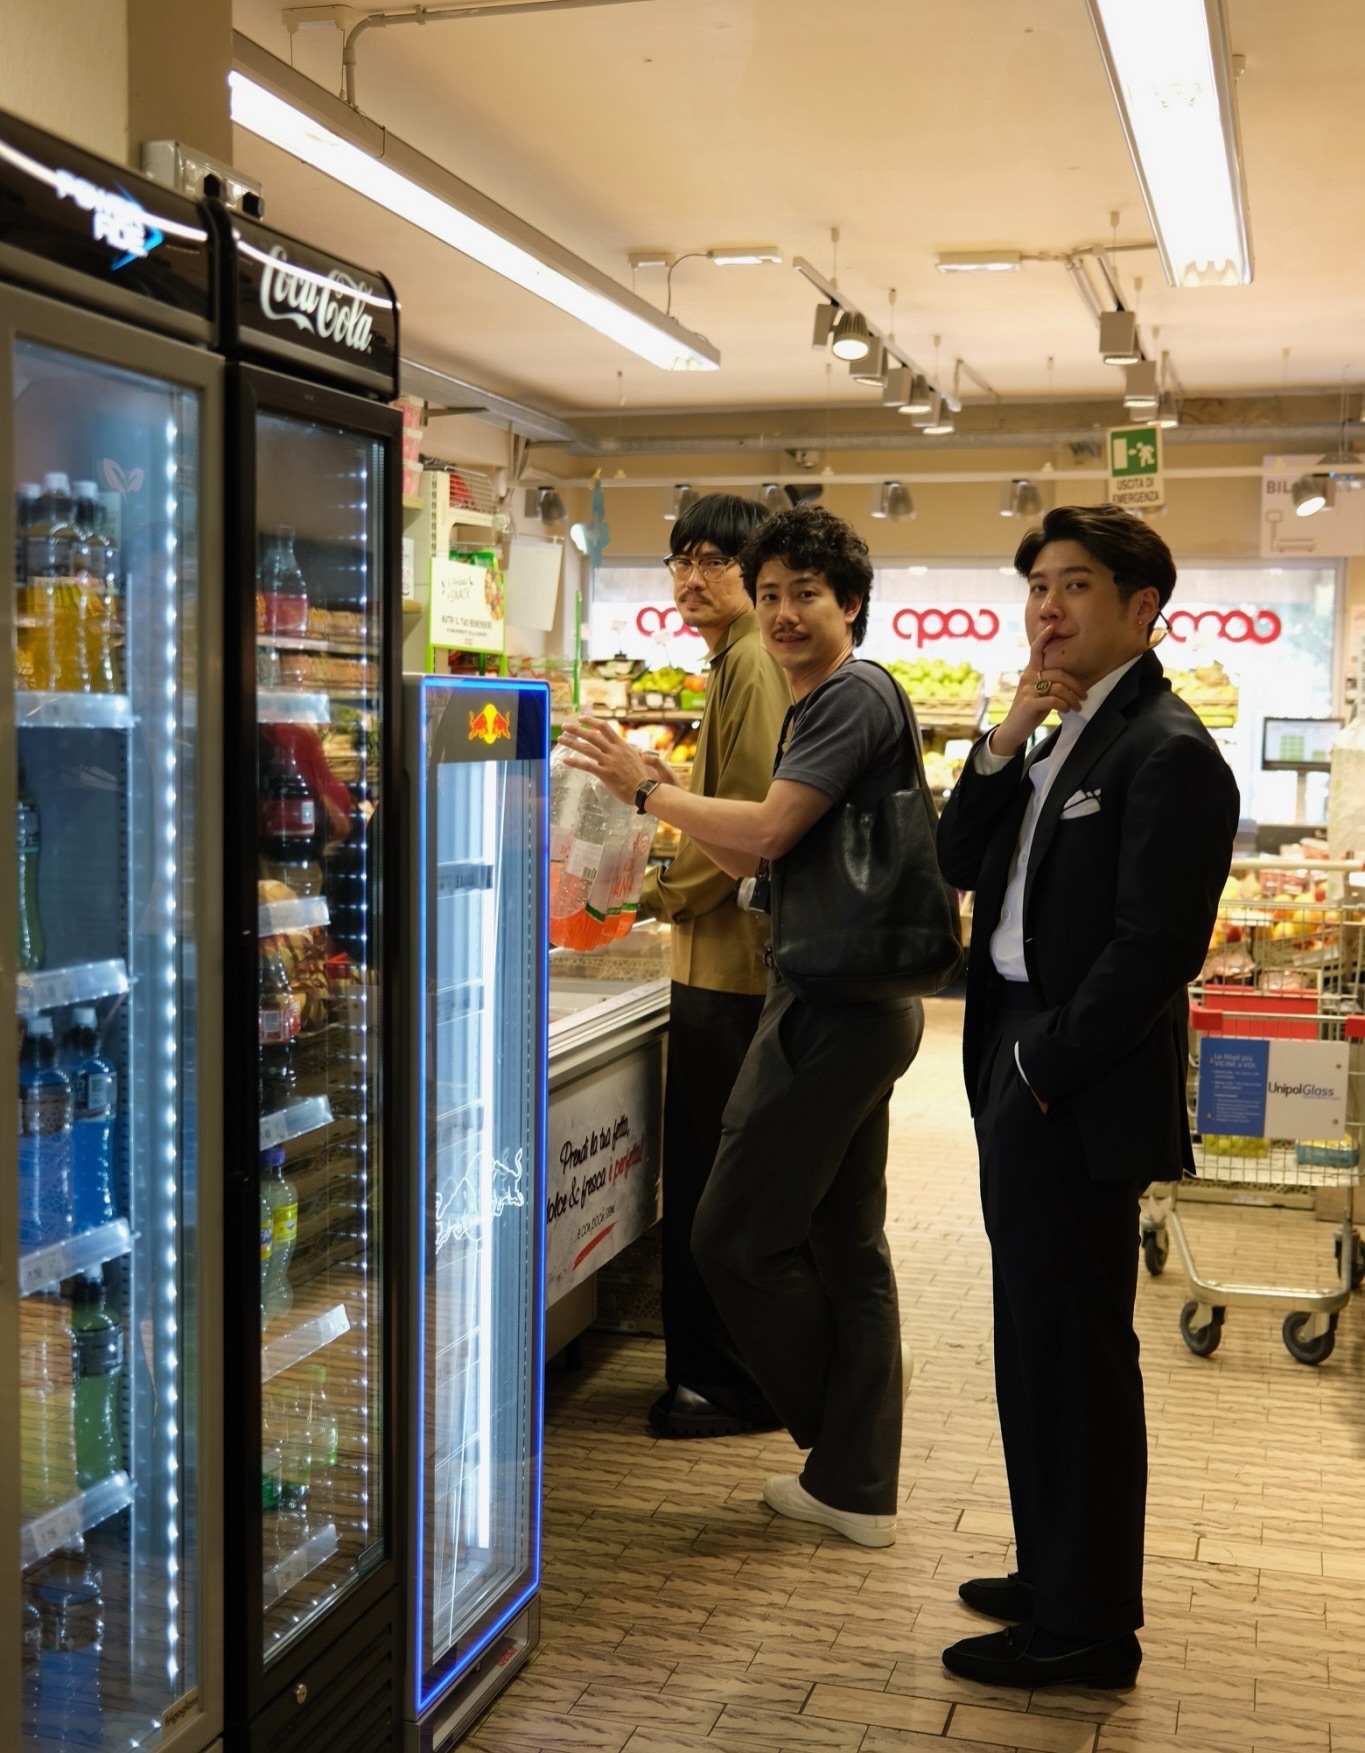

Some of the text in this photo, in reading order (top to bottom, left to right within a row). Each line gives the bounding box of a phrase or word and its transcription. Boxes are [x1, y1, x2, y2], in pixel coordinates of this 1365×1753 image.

[1116, 476, 1155, 491] USCITA DI
[1266, 481, 1293, 494] BIL
[1112, 491, 1159, 504] EMERGENZA
[1268, 1082, 1334, 1098] UnipolGlass
[559, 1136, 588, 1175] Prendi
[590, 1130, 598, 1156] la
[599, 1126, 611, 1150] tua
[568, 1175, 580, 1208] &
[581, 1167, 606, 1209] fresca
